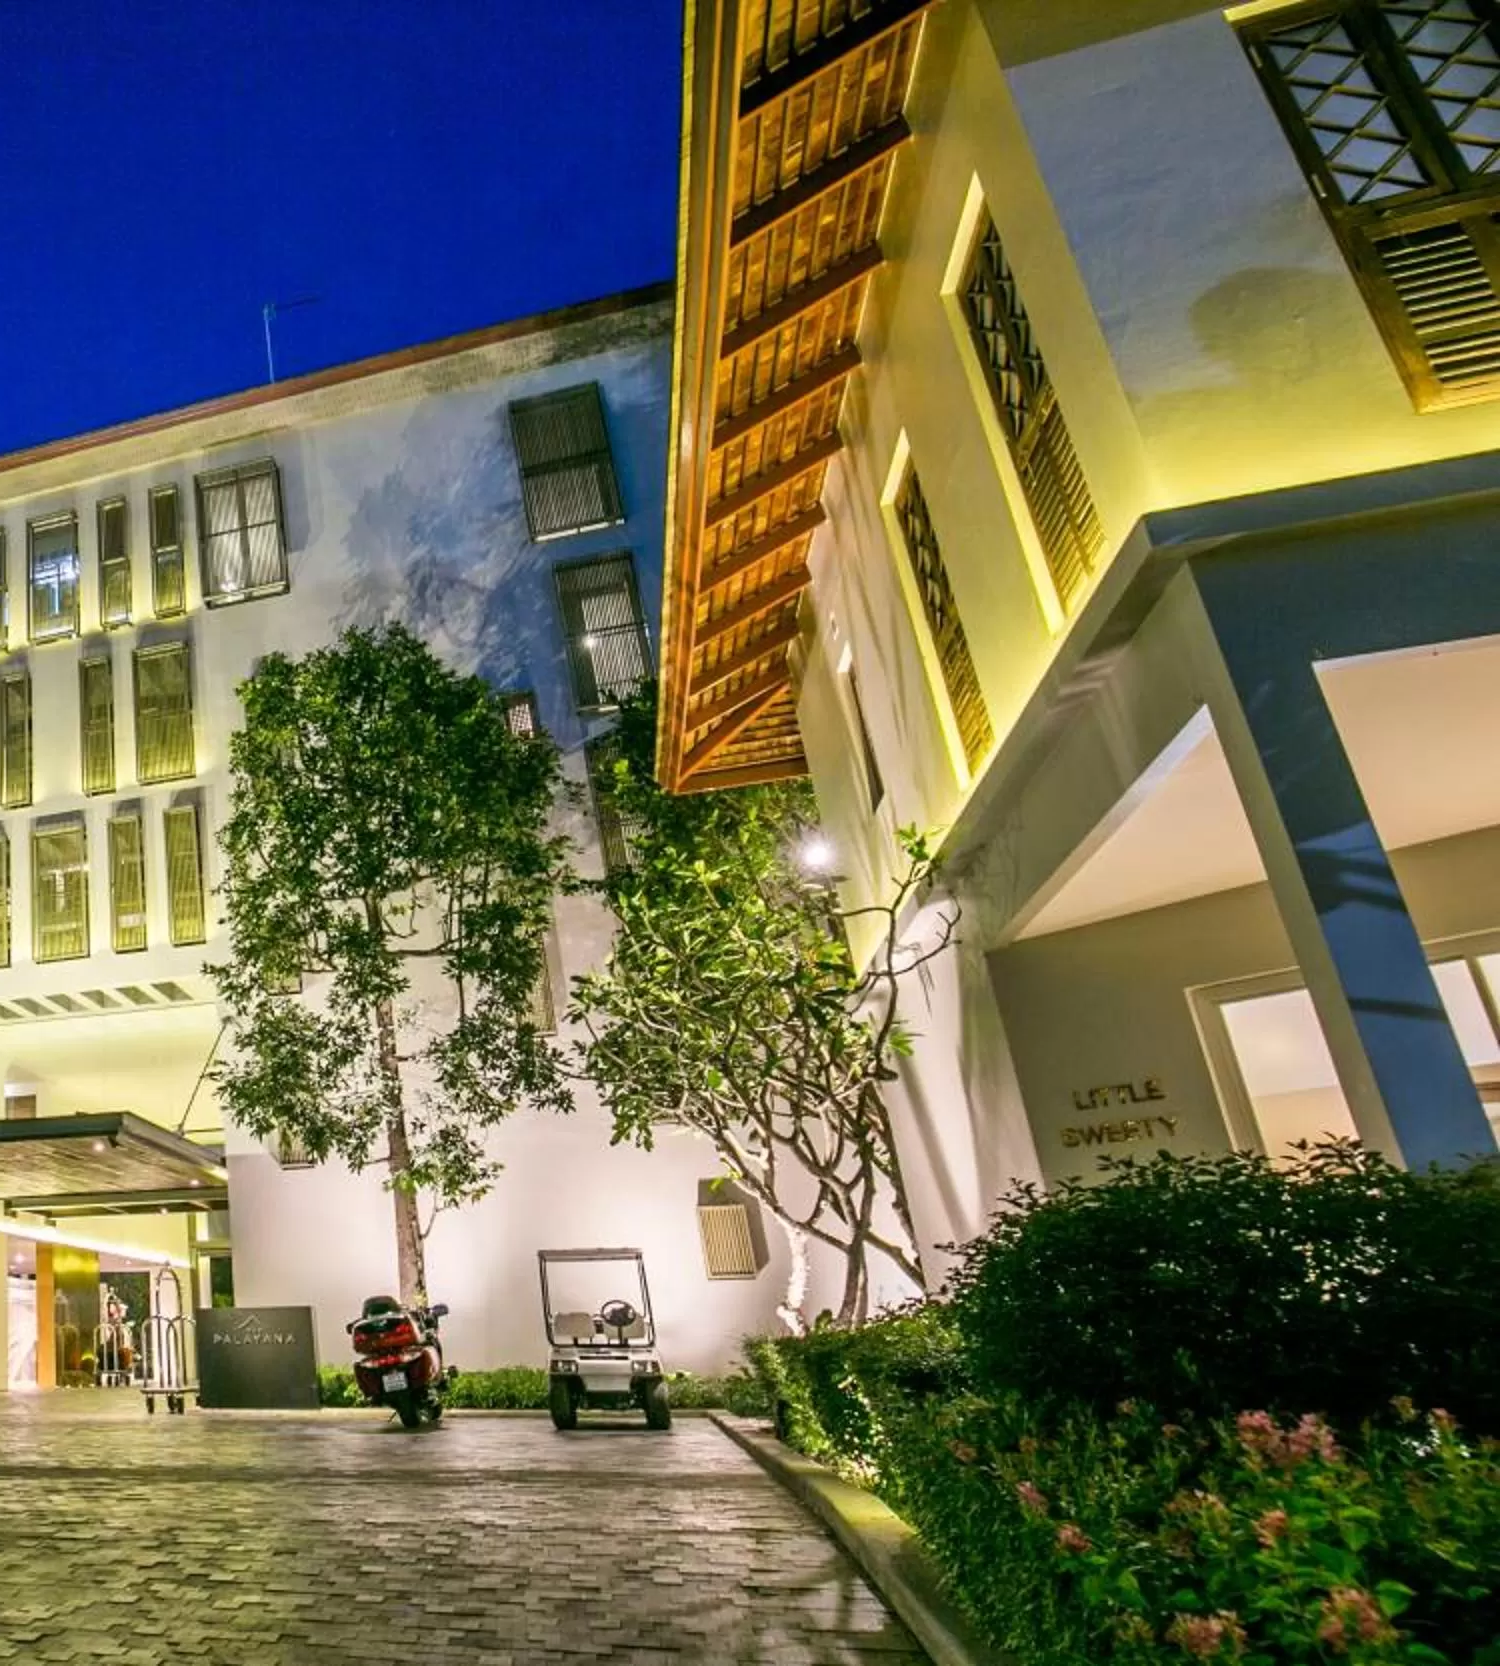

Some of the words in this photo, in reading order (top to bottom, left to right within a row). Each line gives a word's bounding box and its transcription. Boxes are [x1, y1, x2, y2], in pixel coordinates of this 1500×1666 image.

[1071, 1080, 1167, 1110] LITTLE
[1060, 1116, 1177, 1148] SWEETY
[213, 1333, 297, 1345] PALAYANA
